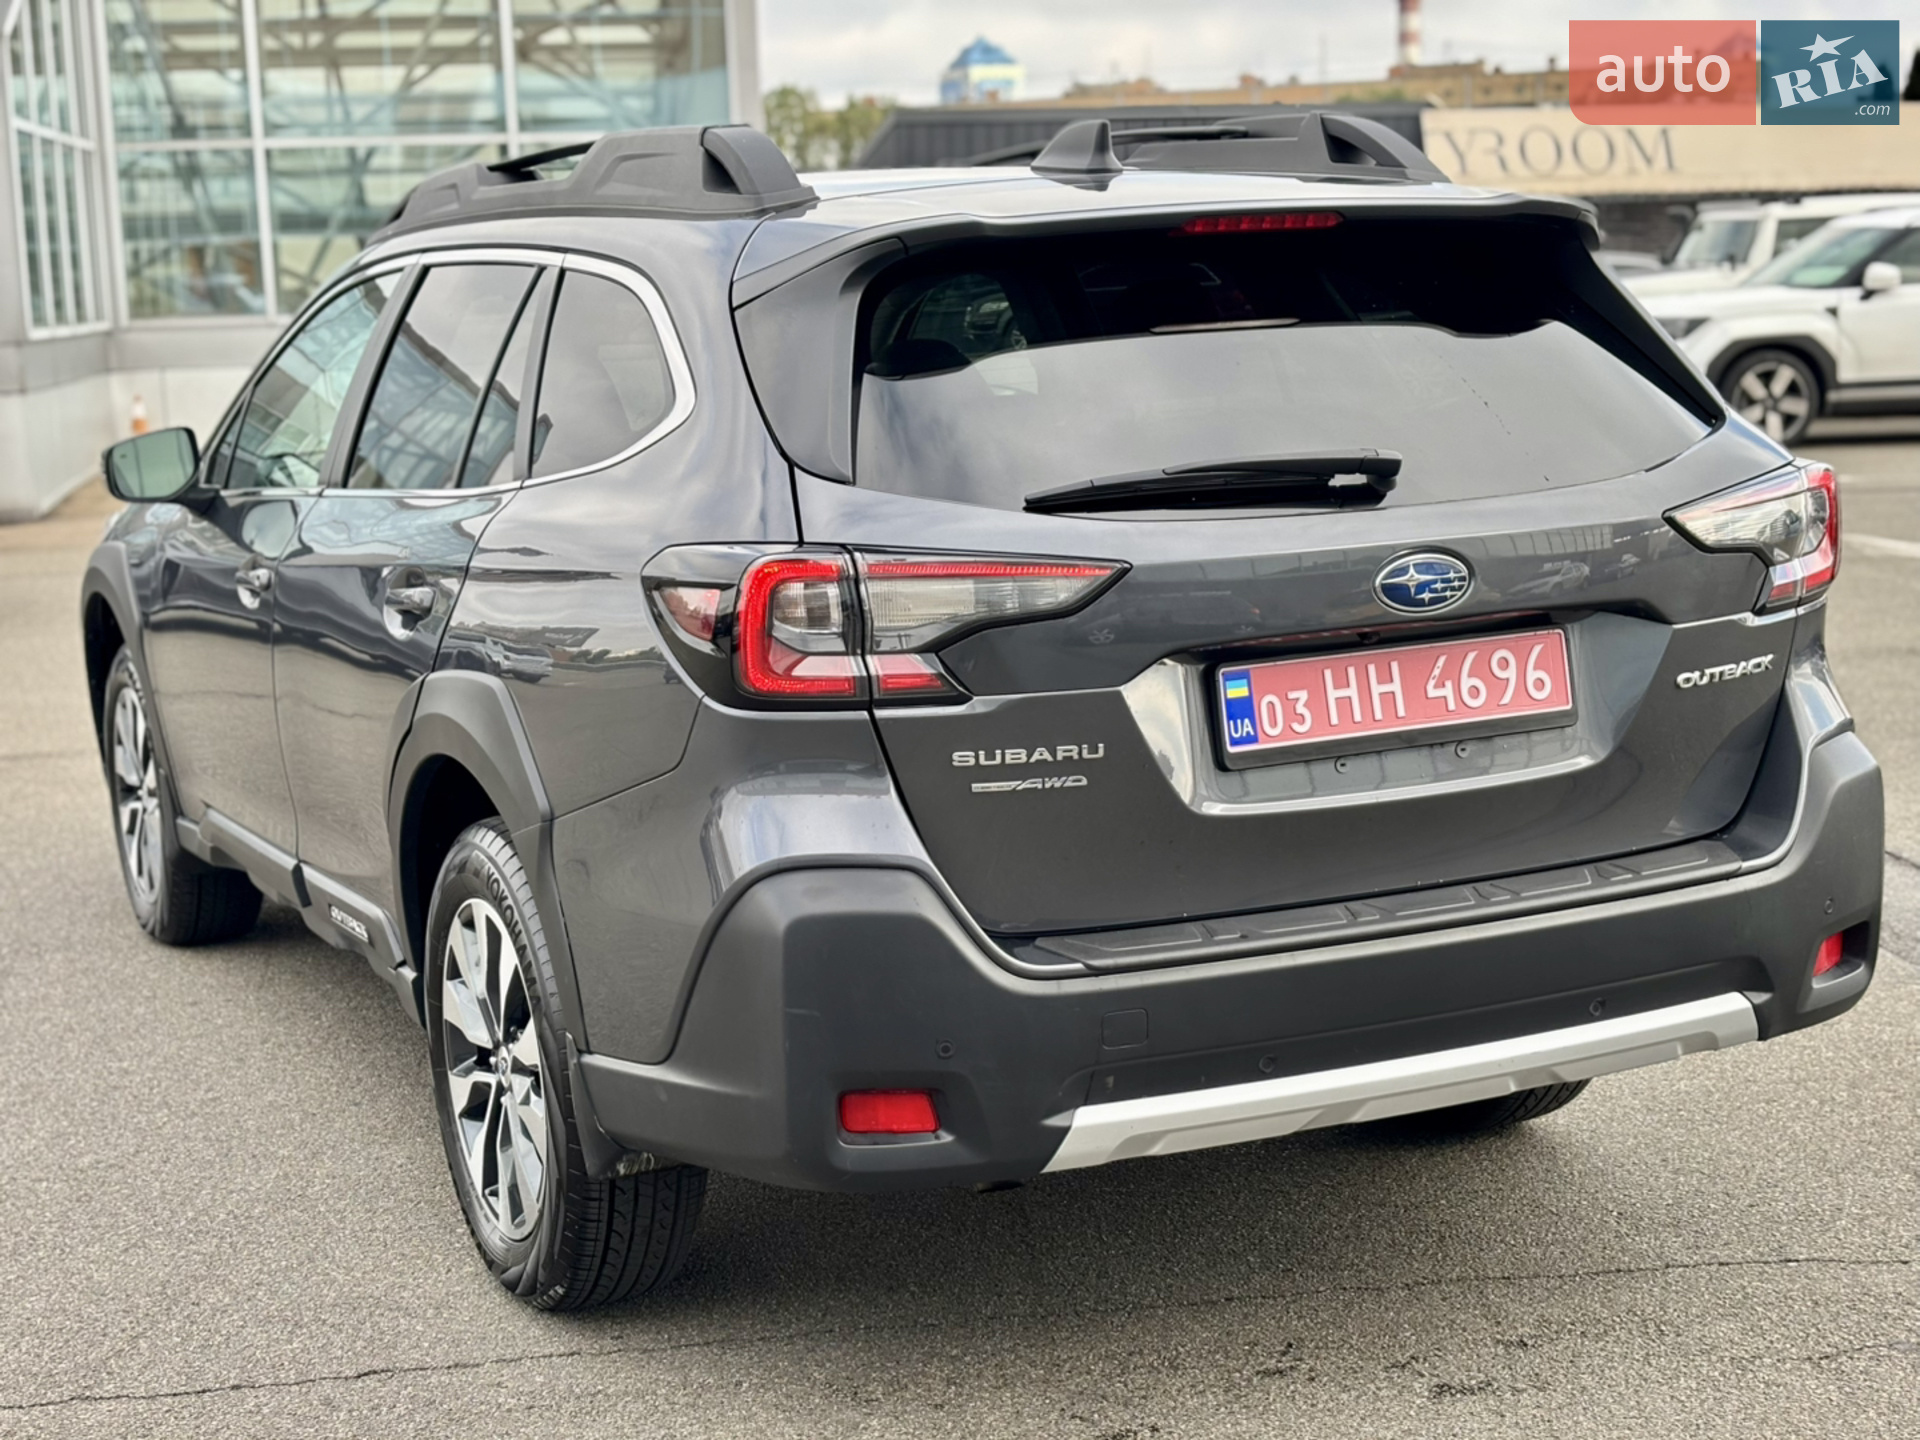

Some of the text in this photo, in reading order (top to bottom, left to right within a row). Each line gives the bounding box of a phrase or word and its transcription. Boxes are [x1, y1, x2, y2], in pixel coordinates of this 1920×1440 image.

[1676, 653, 1774, 688] OUTBACK
[1259, 643, 1552, 737] 03 HH 4696
[1229, 719, 1255, 738] UA
[951, 743, 1105, 766] SUBARU
[1016, 775, 1088, 790] AWD
